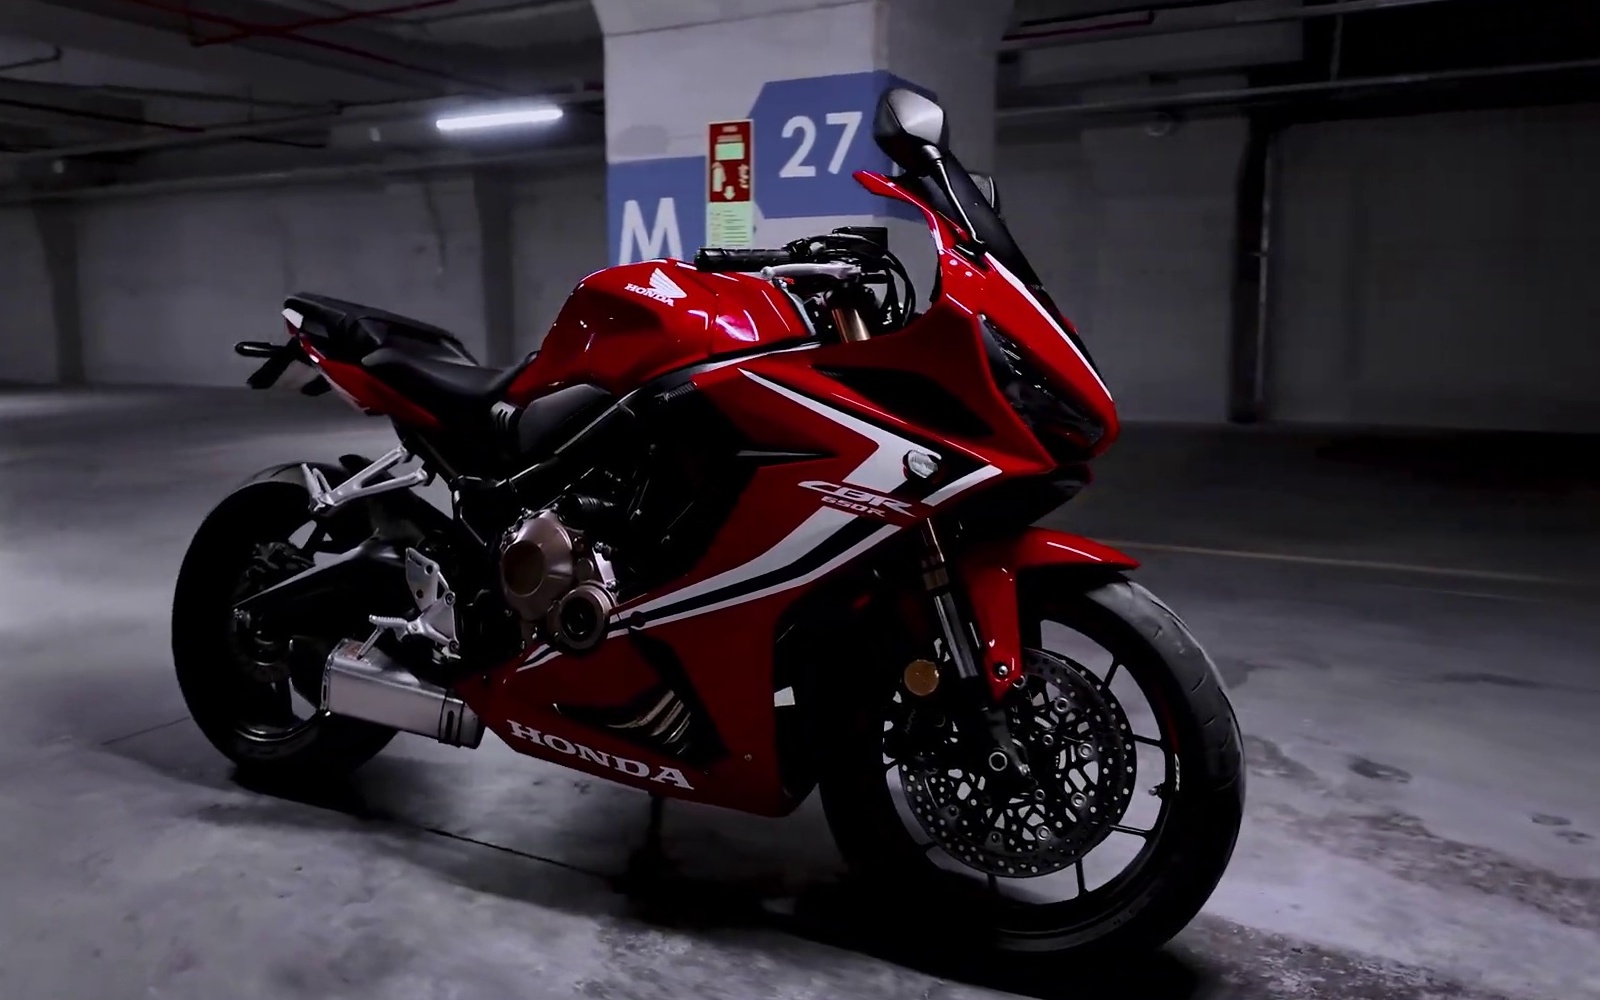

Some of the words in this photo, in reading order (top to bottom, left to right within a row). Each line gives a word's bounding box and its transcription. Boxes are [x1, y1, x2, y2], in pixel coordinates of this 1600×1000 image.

[779, 112, 863, 178] 27
[618, 197, 684, 264] M
[624, 283, 675, 307] HONDA
[798, 480, 917, 518] CBR
[506, 719, 695, 790] HONDA
